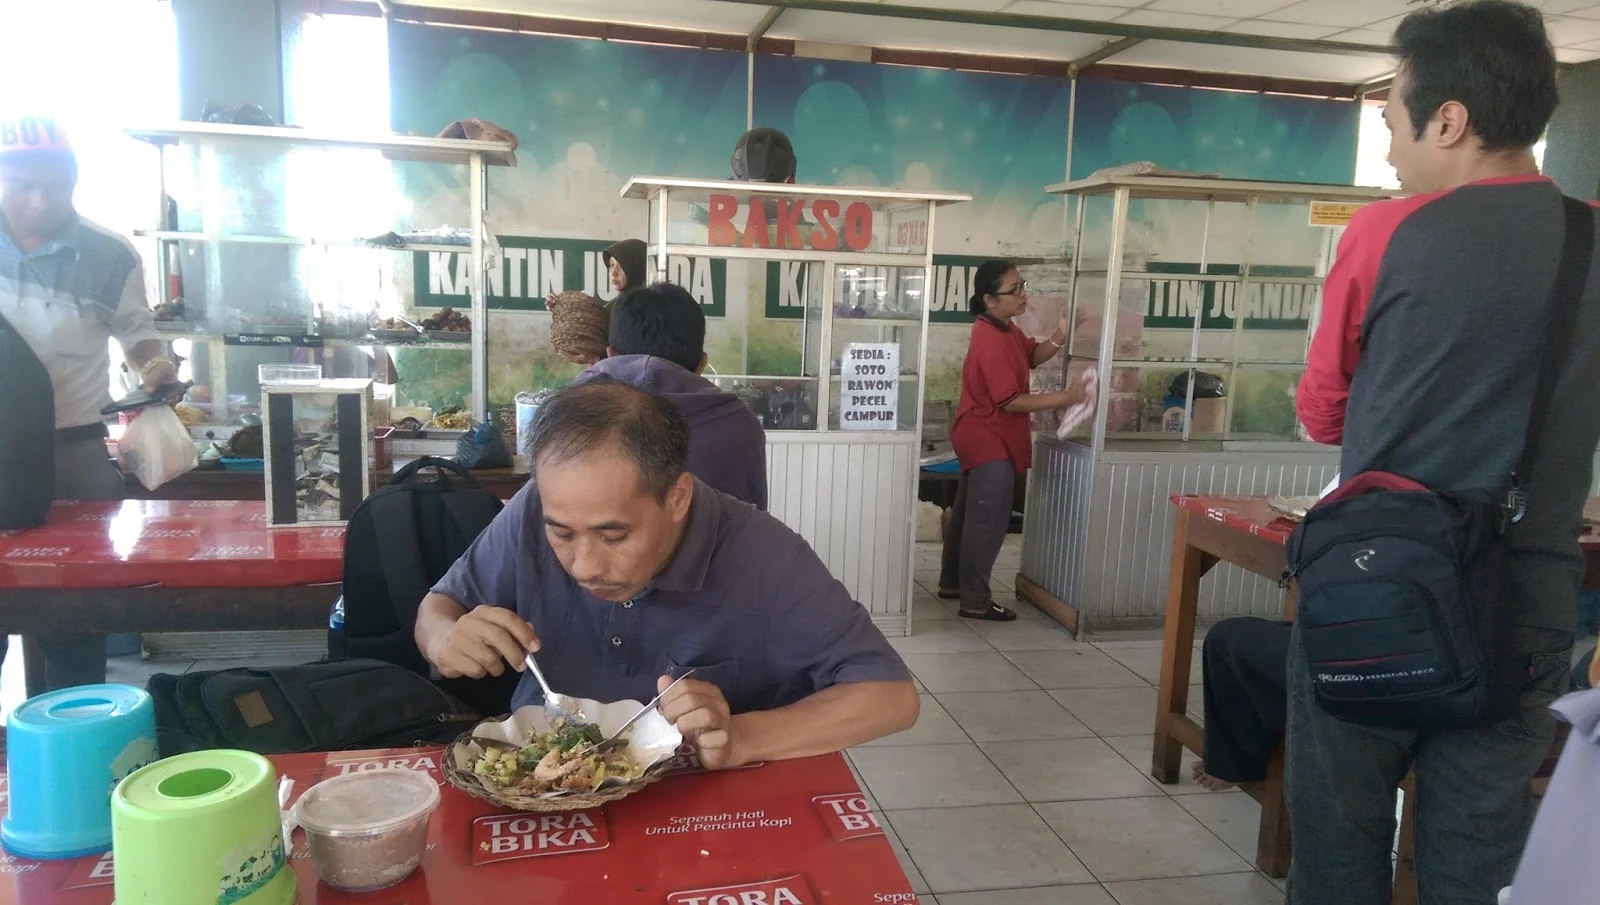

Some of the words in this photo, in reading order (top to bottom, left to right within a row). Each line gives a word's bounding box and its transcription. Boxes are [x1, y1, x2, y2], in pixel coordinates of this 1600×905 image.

[708, 194, 873, 251] BAKSO
[850, 349, 884, 360] SEDIA
[855, 364, 886, 375] SOTO
[847, 380, 893, 391] RAWON
[852, 395, 887, 406] PECEL
[844, 410, 894, 422] CAMPUR
[483, 813, 595, 837] TORA
[670, 813, 732, 826] Sepenuh
[736, 810, 765, 820] Hati
[645, 824, 689, 835] Untuk
[694, 820, 756, 832] Pencinta
[760, 817, 792, 829] Kopi
[491, 829, 597, 854] BIKA
